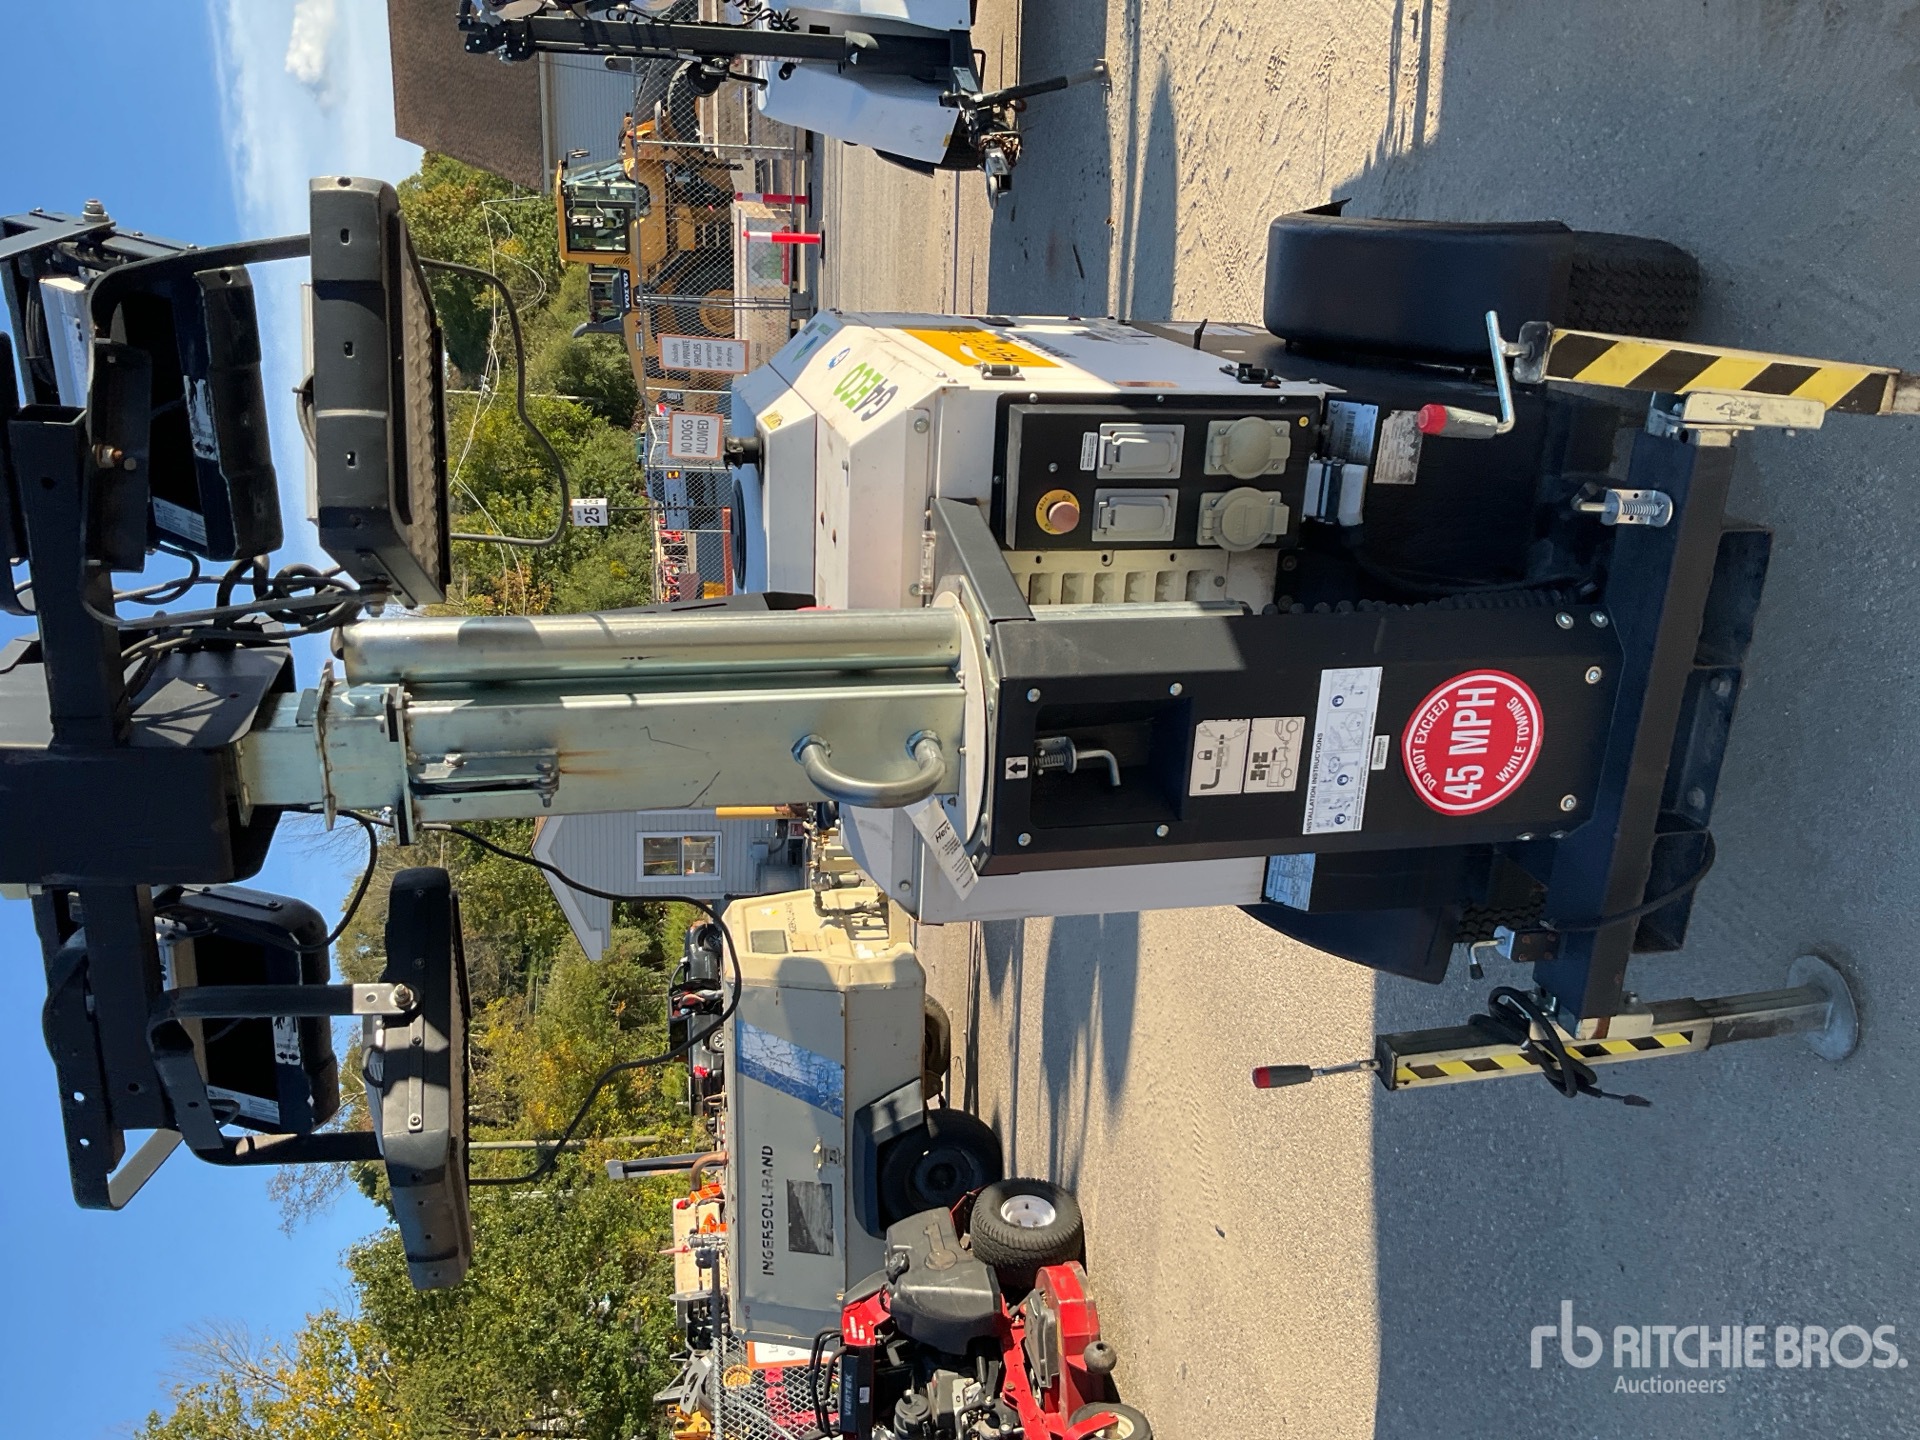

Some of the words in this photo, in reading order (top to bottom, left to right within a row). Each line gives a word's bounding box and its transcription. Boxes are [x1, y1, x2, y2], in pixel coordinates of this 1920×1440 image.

[623, 272, 631, 309] VOLVO
[682, 340, 690, 360] PRIVATE
[694, 344, 702, 366] VEHICLES
[833, 362, 898, 422] G4ECO
[681, 442, 692, 453] NO
[682, 420, 693, 440] DOGS
[696, 420, 709, 454] ALLOWED
[584, 508, 600, 523] 25
[1414, 698, 1450, 744] EXCEED
[1448, 687, 1498, 755] MPH
[1506, 696, 1530, 743] TOWING
[1310, 732, 1323, 784] INSTRUCTIONS
[1413, 748, 1428, 773] NOT
[1496, 746, 1526, 782] WHILE
[1422, 772, 1438, 790] DO
[1443, 765, 1485, 799] 45
[1306, 785, 1317, 833] INSTALLATION
[844, 1373, 852, 1416] VERTEX
